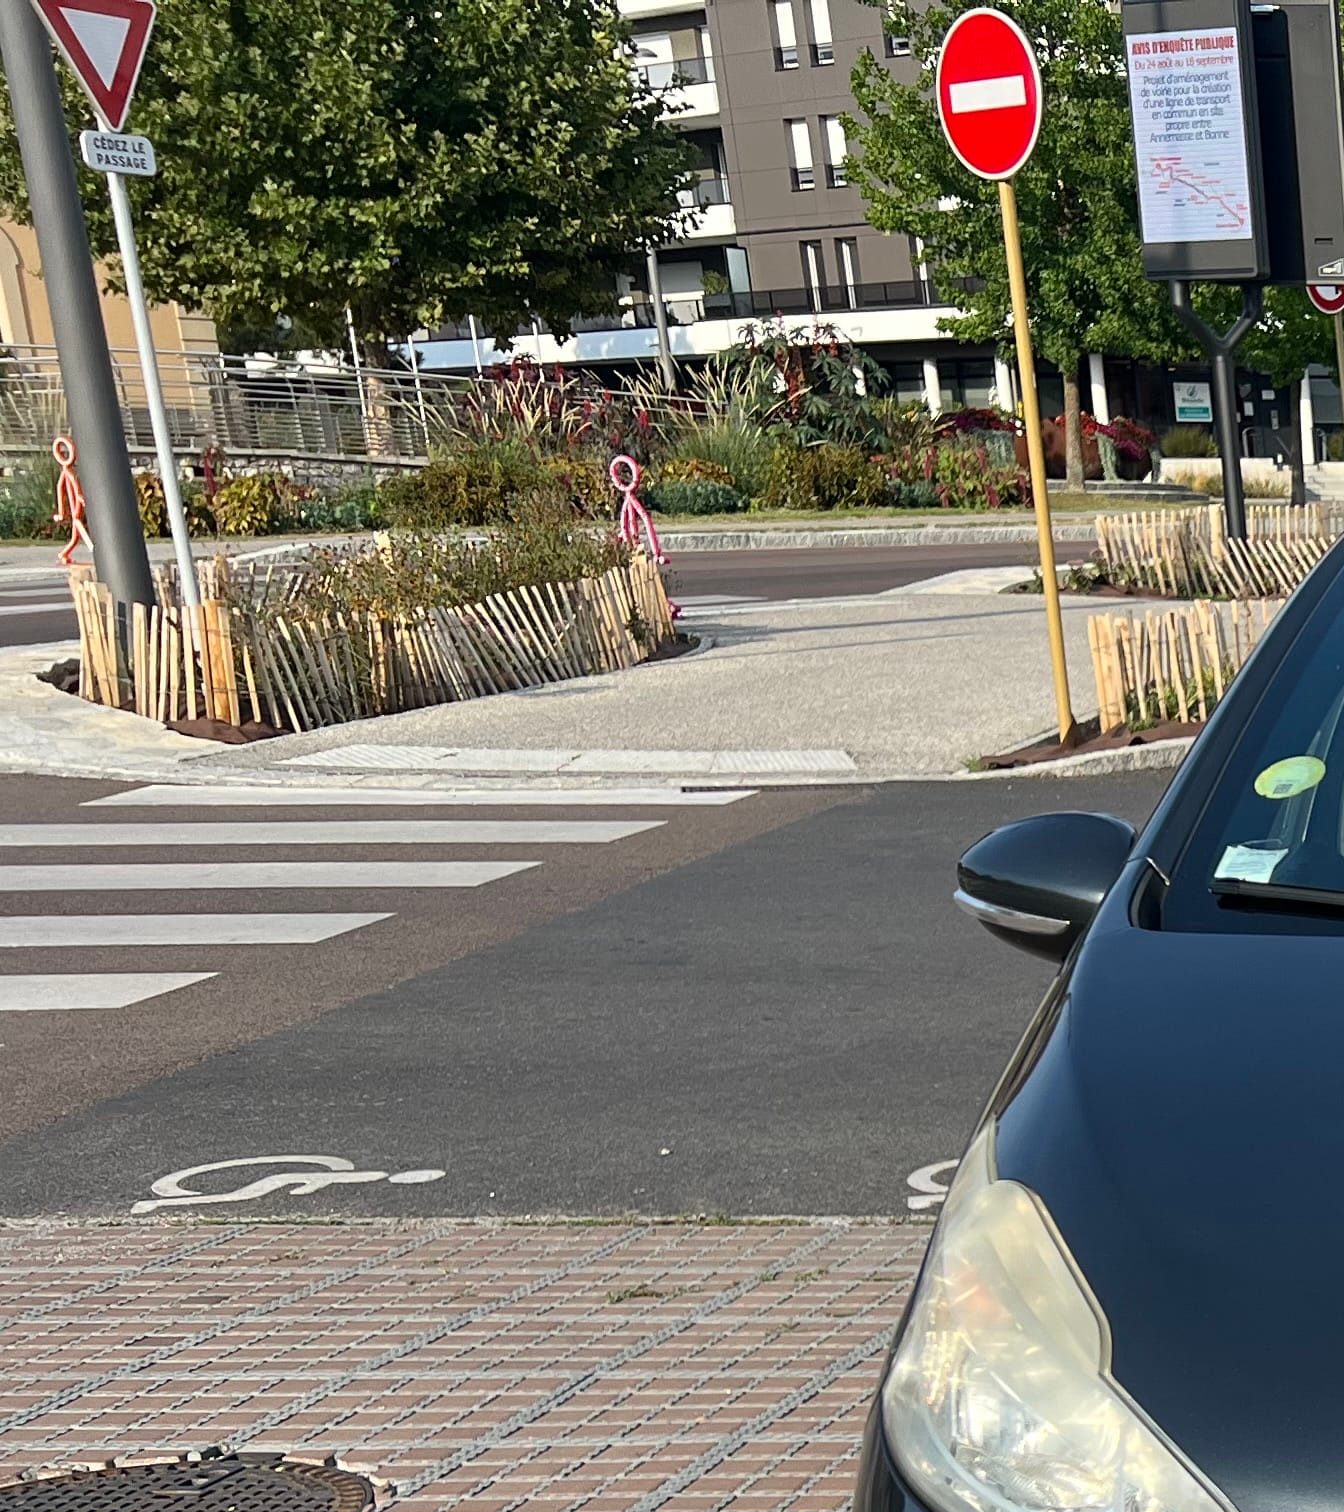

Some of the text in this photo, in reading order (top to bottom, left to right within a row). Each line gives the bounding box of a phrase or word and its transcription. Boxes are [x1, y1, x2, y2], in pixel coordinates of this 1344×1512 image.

[1132, 36, 1234, 55] AVIS D'ENQUÊTE PUBLIQUE
[1134, 60, 1145, 70] Du
[1147, 59, 1156, 69] 24
[1157, 57, 1173, 68] août
[1196, 55, 1234, 68] septembre
[1143, 71, 1229, 88] Projet d'aménagement
[1140, 83, 1232, 97] de voirie pour la création
[1143, 94, 1231, 109] d'une ligne de transport
[1151, 106, 1224, 120] en commun en site
[1165, 119, 1212, 132] propre entre
[1195, 131, 1203, 140] et
[93, 136, 146, 154] CÉDEZ LE
[96, 153, 148, 170] PASSAGE
